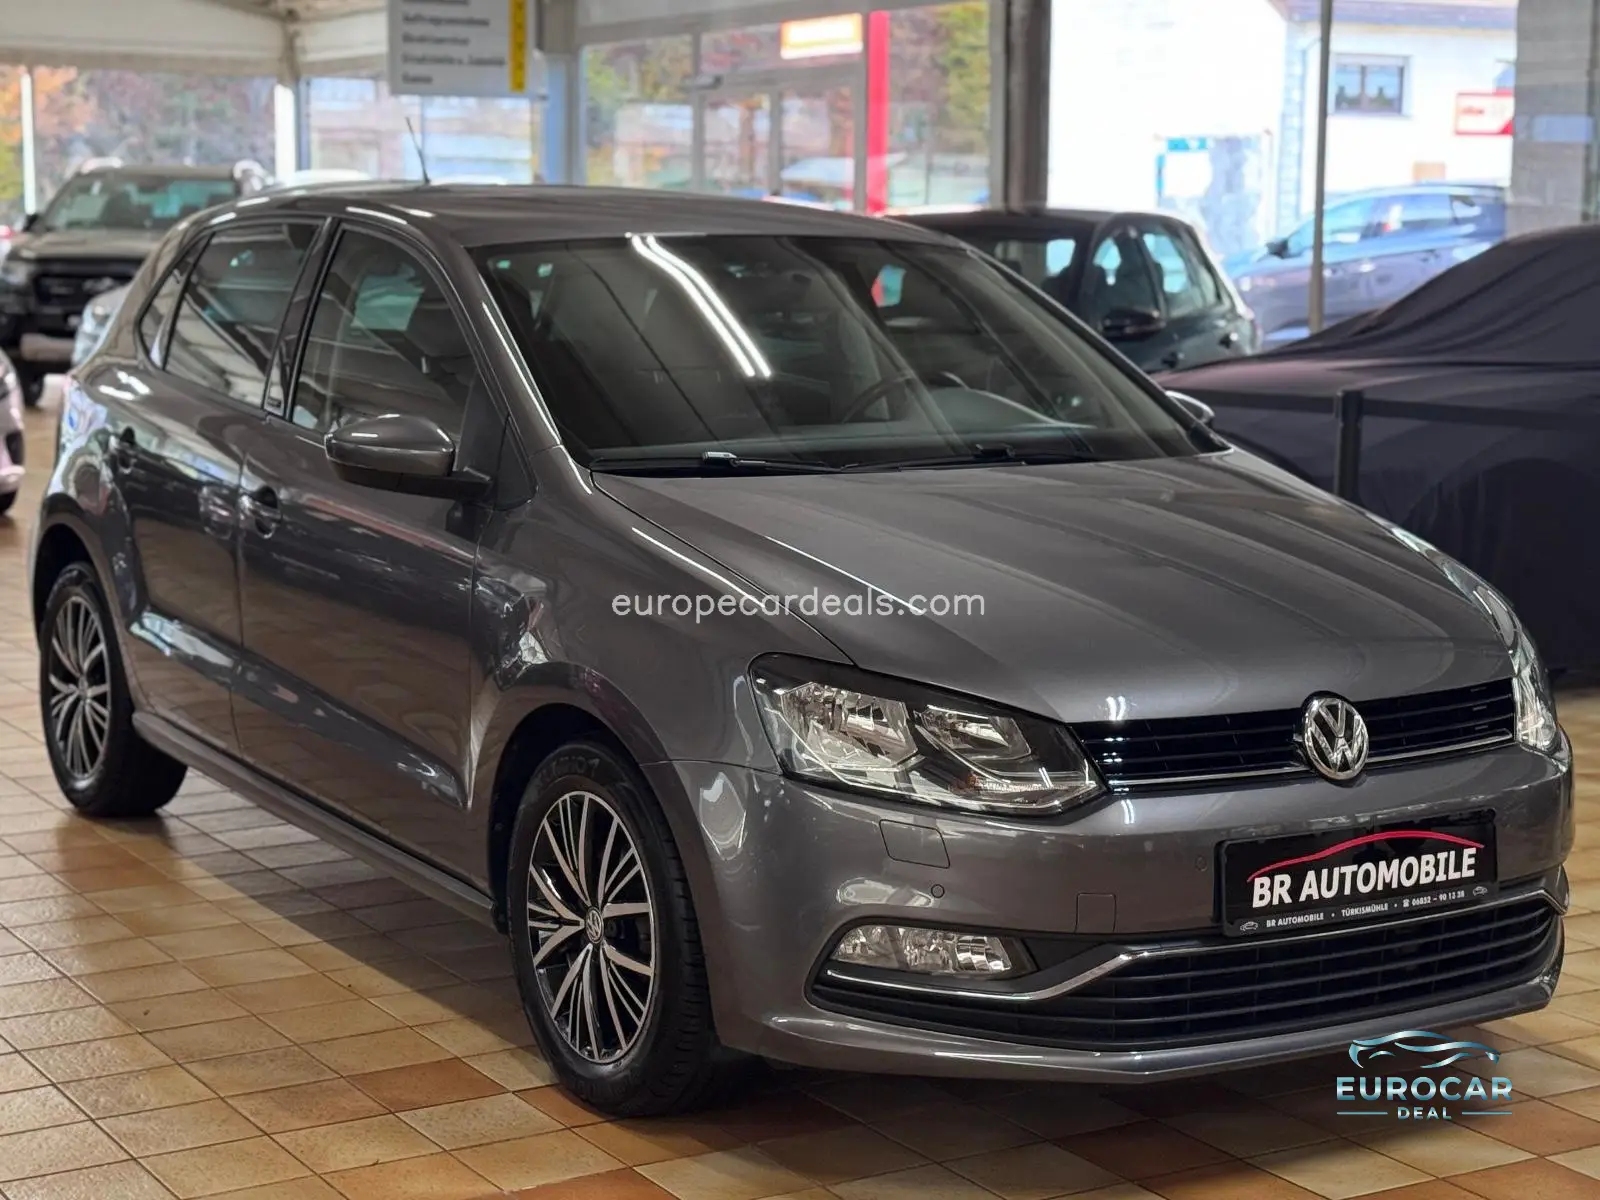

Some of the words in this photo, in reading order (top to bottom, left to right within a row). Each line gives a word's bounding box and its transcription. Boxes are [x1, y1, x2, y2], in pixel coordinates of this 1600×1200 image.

[1306, 698, 1367, 778] VW
[1252, 874, 1293, 909] BR
[1299, 847, 1478, 902] AUTOMOBILE
[1266, 919, 1277, 928] BR
[1277, 912, 1324, 926] AUTOMOBILE
[1341, 903, 1389, 917] TÜRKISMÜHLE
